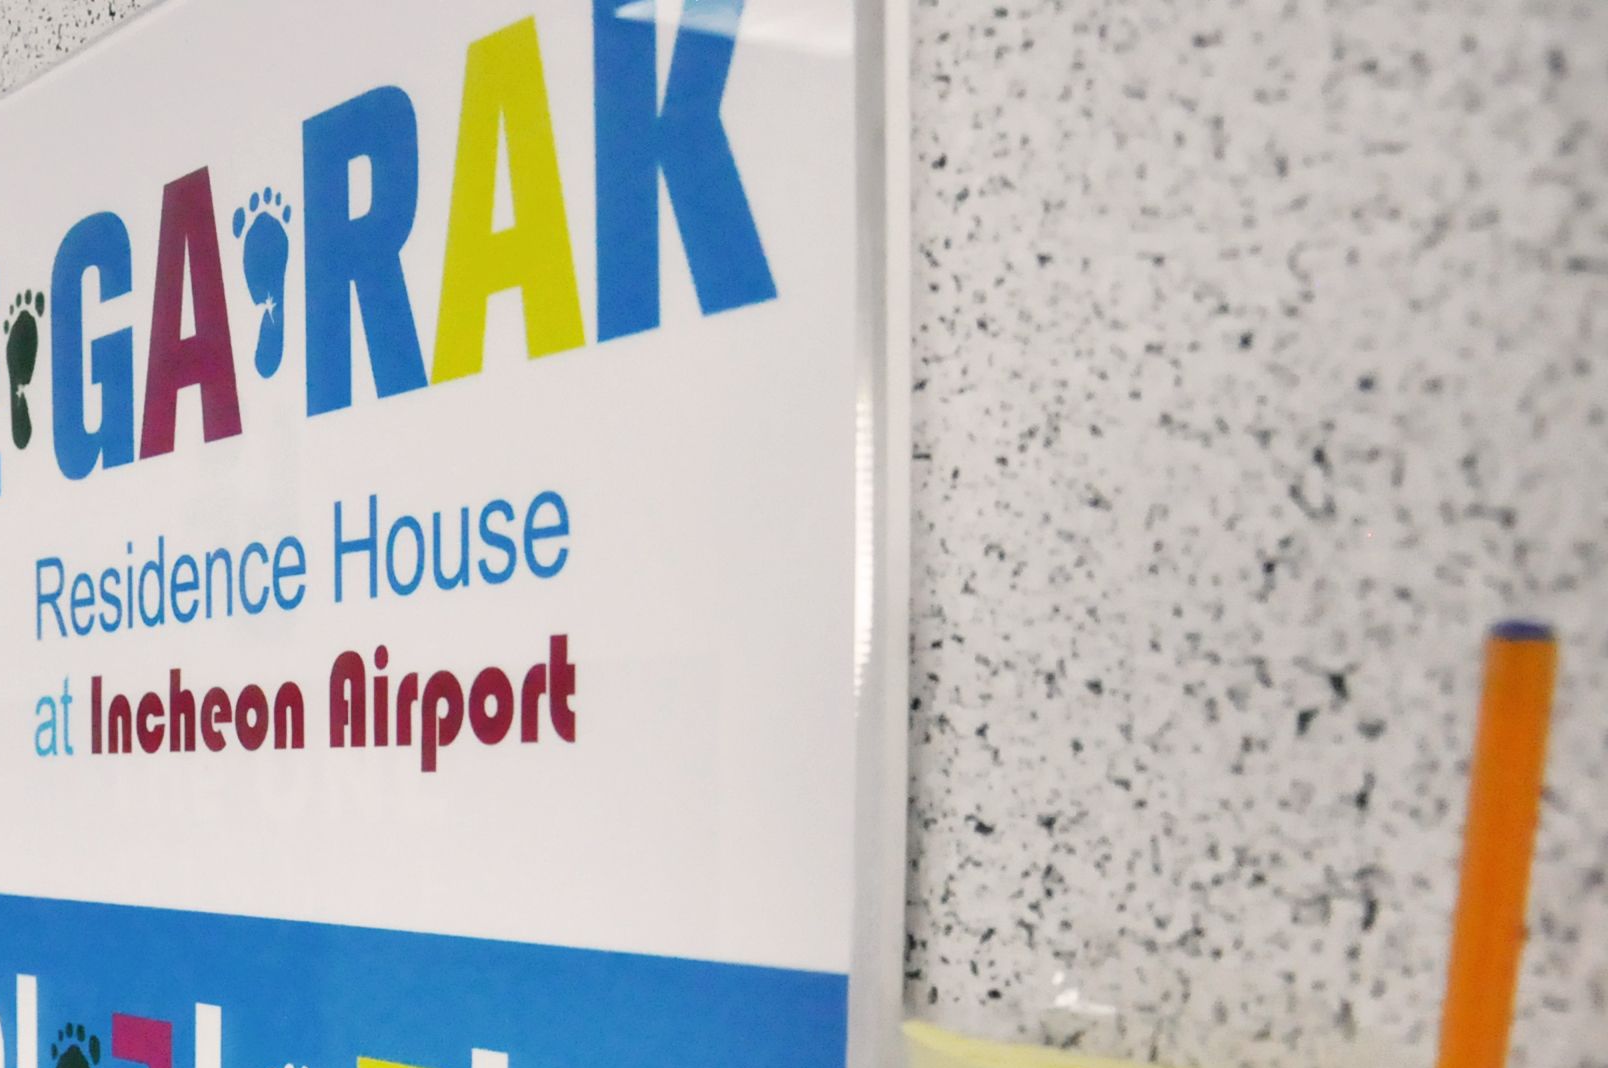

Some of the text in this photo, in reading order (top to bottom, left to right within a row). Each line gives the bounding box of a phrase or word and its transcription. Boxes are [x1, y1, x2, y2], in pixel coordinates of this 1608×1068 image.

[35, 490, 570, 641] Residence House
[34, 634, 576, 773] at Incheon Airport
